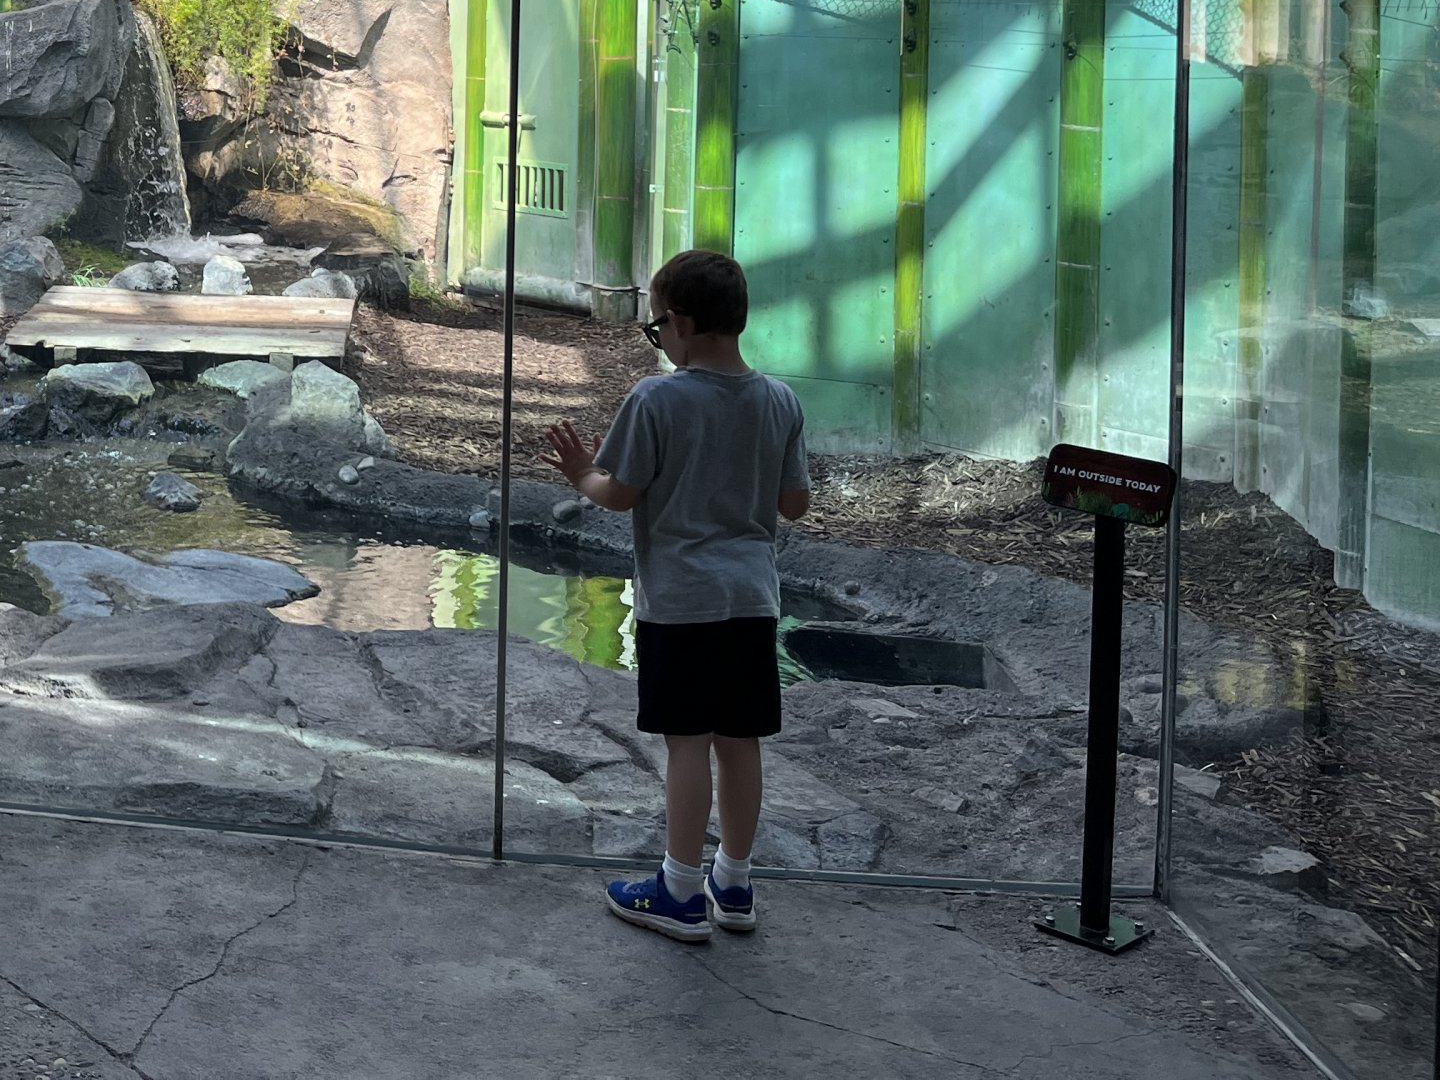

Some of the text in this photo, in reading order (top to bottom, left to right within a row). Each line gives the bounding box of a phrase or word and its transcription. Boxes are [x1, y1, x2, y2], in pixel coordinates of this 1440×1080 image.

[1054, 465, 1161, 493] I AM OUTSIDE TODAY
